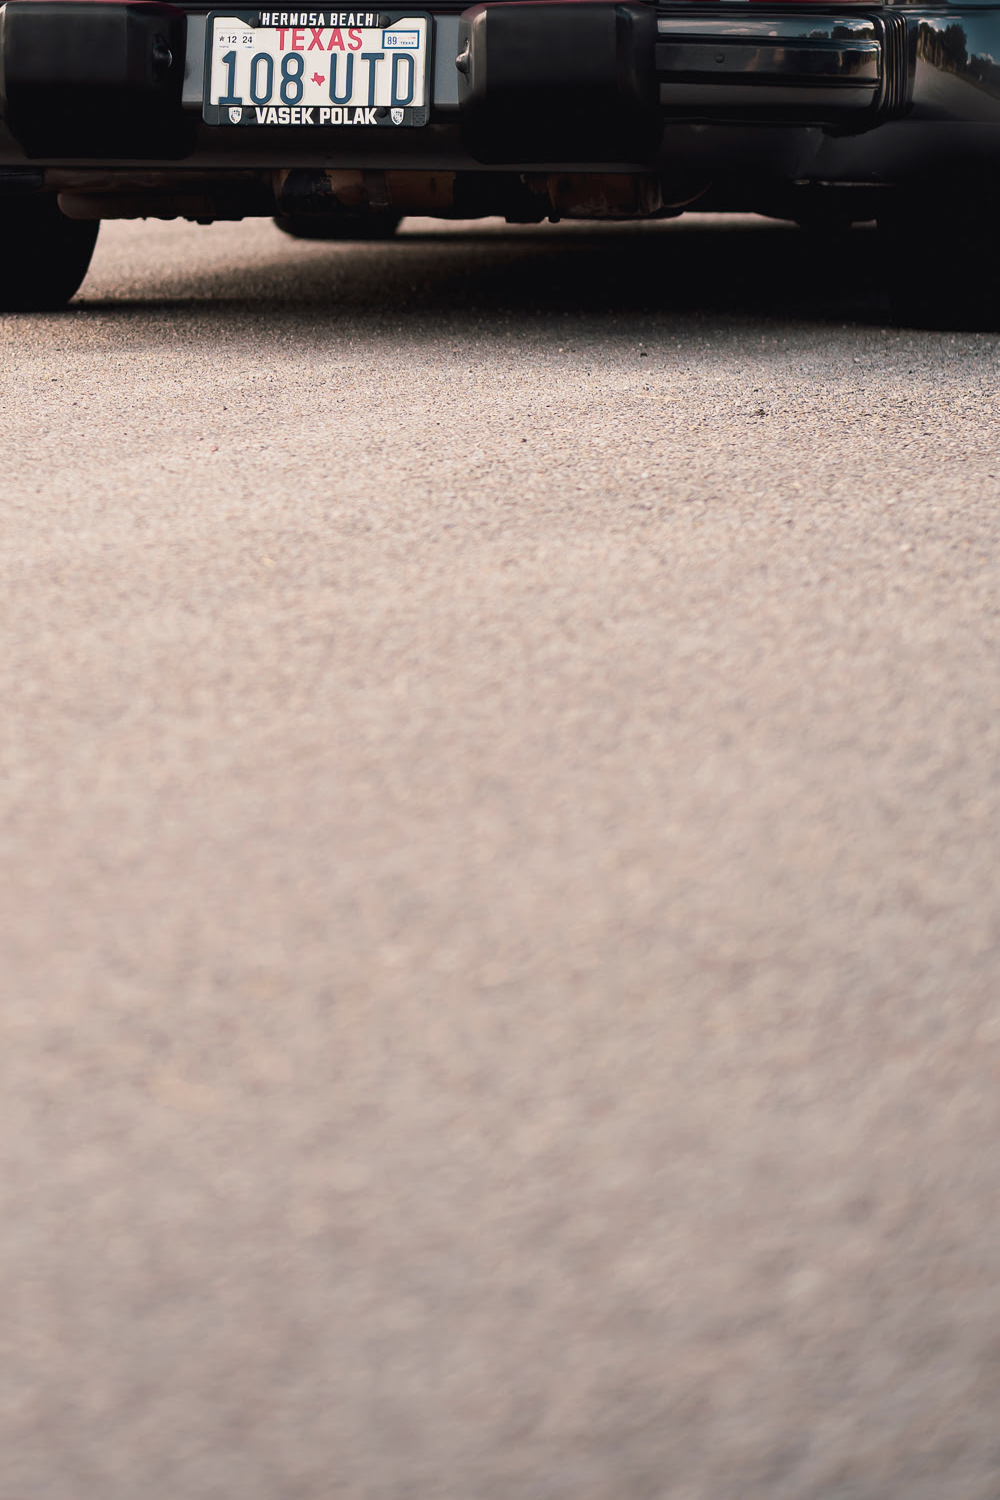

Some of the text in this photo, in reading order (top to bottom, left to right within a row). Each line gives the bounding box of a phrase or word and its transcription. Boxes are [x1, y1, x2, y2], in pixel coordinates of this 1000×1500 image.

[262, 12, 373, 27] HERMOSA BEACH
[227, 35, 253, 44] 12 24
[276, 28, 363, 51] TEXAS
[387, 35, 398, 46] 89
[218, 50, 415, 106] 108 UTD
[255, 107, 378, 124] VASEK POLAK
